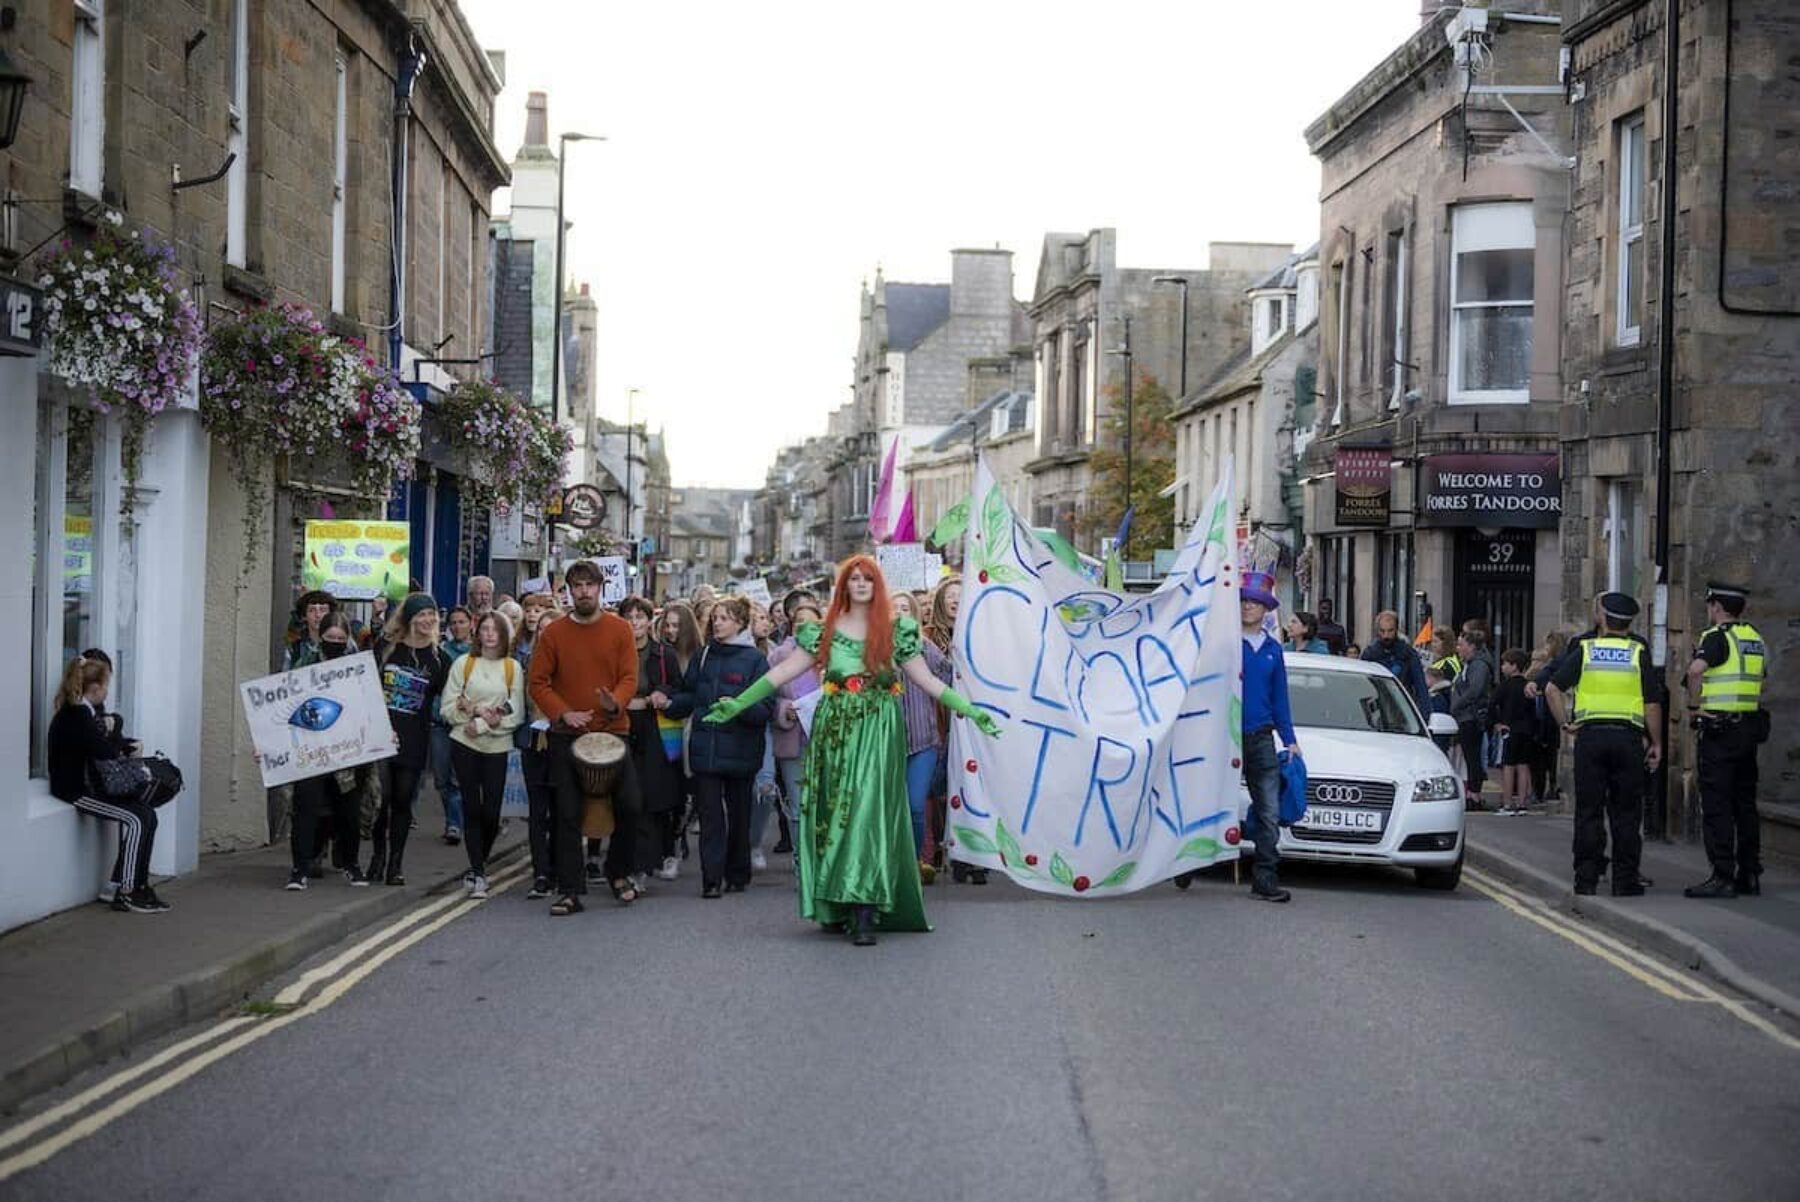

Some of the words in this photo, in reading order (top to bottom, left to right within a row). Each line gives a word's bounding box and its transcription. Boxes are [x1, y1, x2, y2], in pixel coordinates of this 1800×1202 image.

[7, 291, 32, 340] 12
[1438, 472, 1513, 489] WELCOME
[1517, 474, 1543, 489] TO
[1488, 542, 1515, 563] 39
[1591, 648, 1632, 662] POLICE
[248, 671, 304, 711] Don't
[263, 752, 291, 770] her
